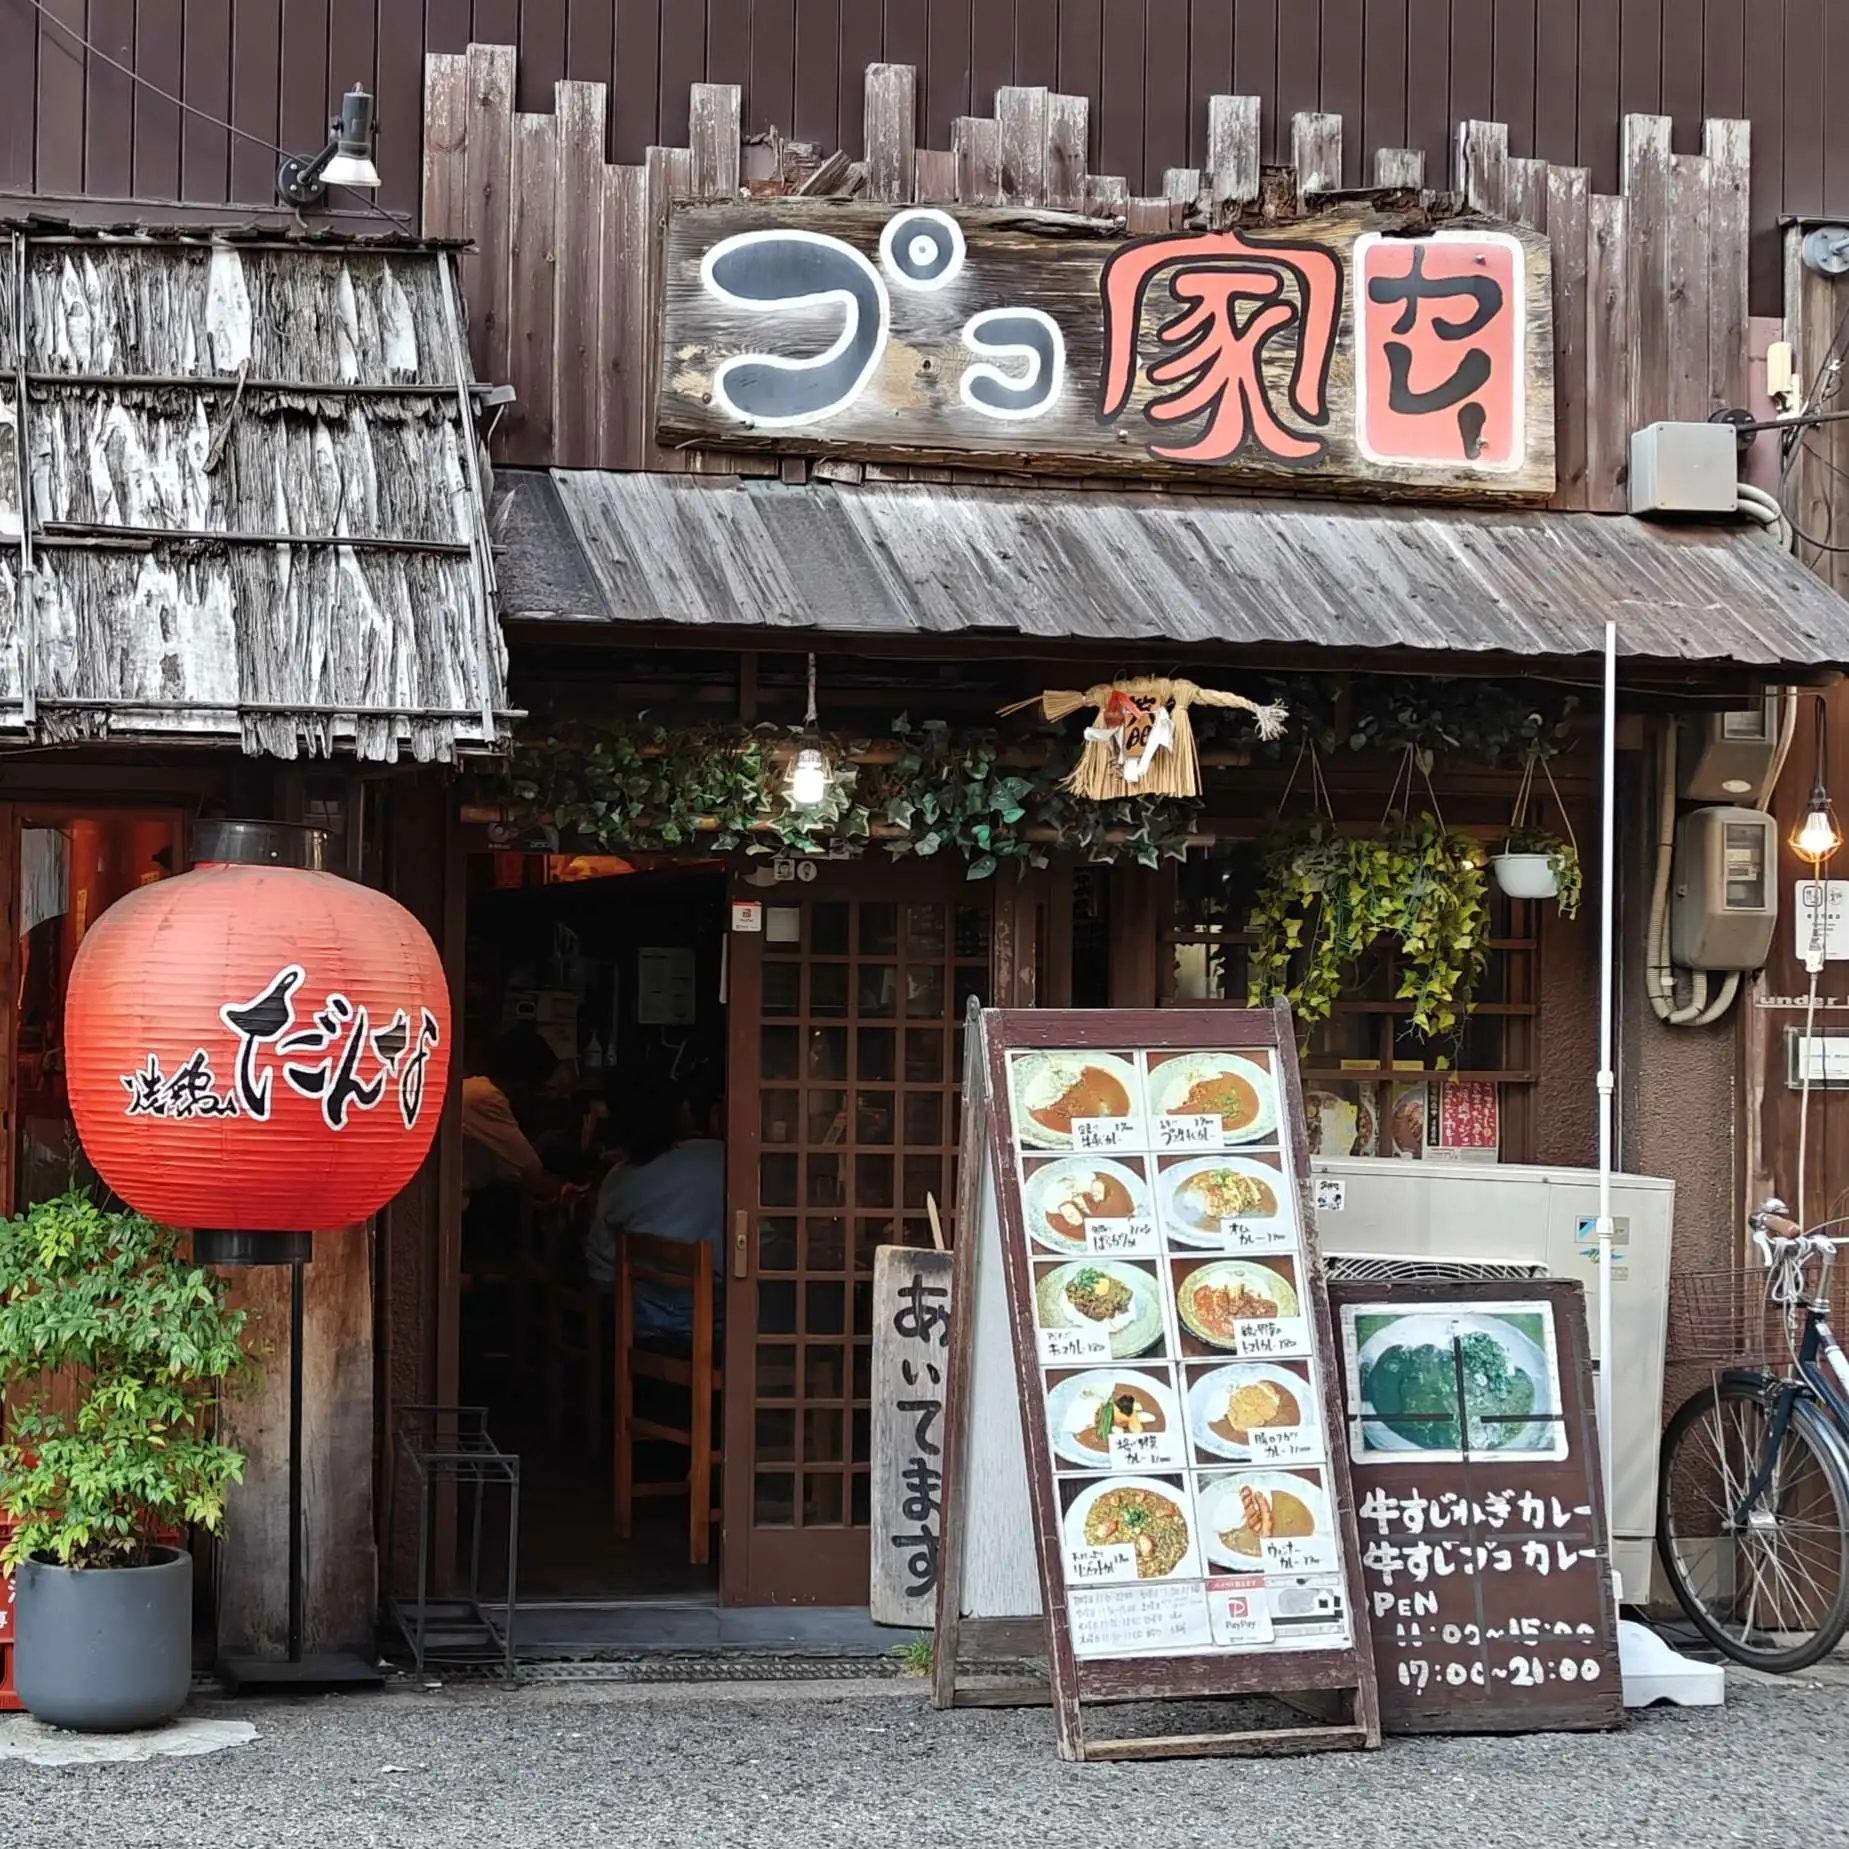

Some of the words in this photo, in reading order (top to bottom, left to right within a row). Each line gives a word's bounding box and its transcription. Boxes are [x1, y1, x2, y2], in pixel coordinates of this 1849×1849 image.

[891, 1273, 951, 1598] あいてます
[1225, 1620, 1256, 1630] PayPay
